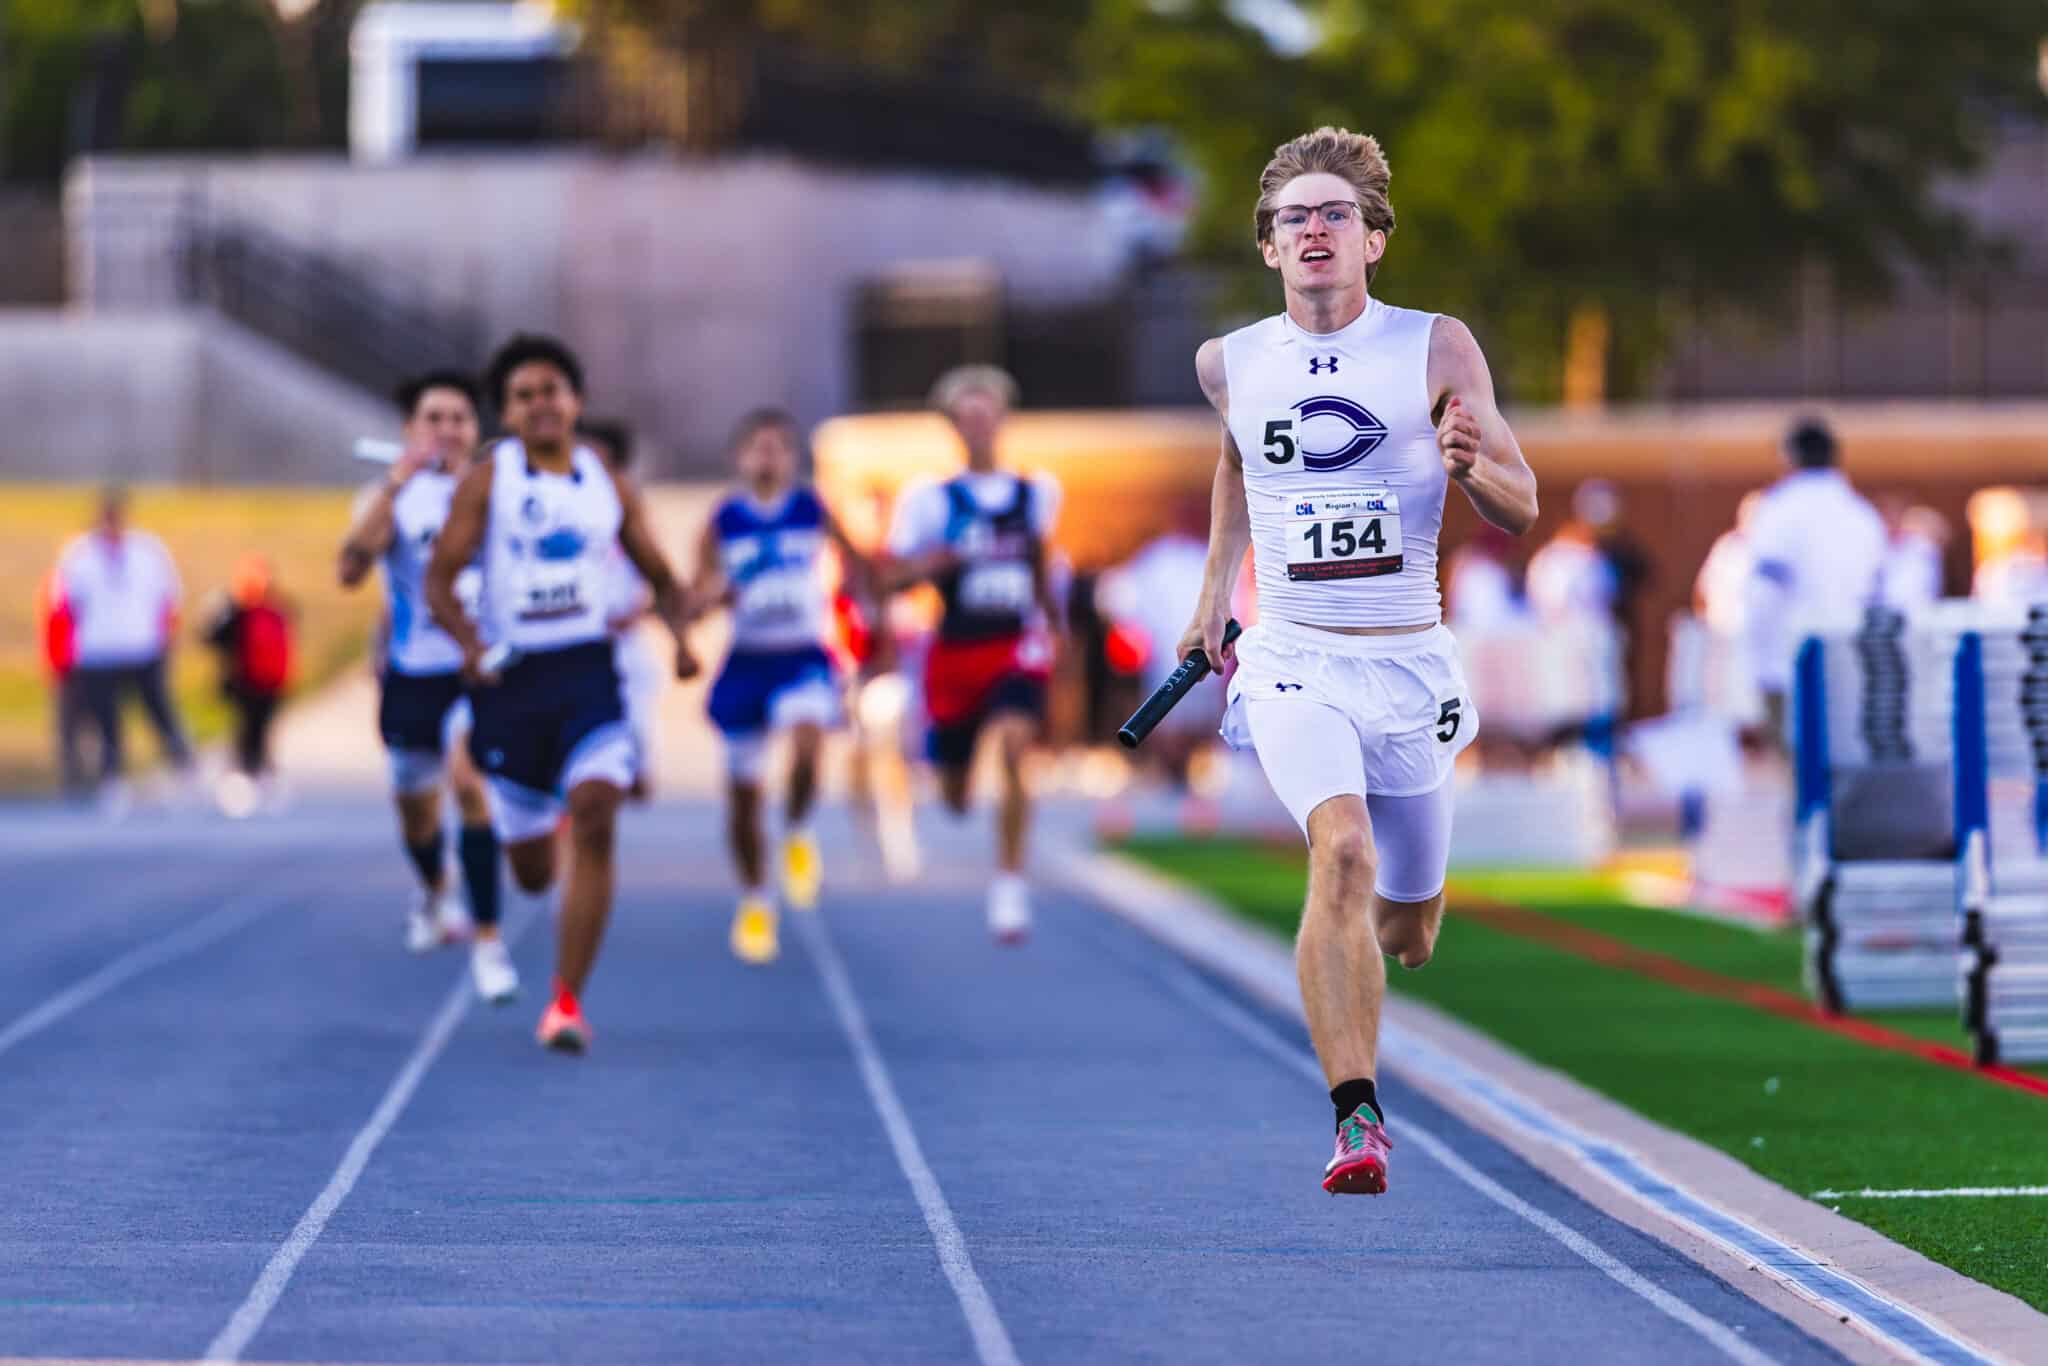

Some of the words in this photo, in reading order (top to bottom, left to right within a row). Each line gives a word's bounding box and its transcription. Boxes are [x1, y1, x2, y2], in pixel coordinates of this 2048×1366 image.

[1263, 419, 1295, 465] 5
[1303, 518, 1386, 559] 154
[1436, 697, 1461, 743] 5
